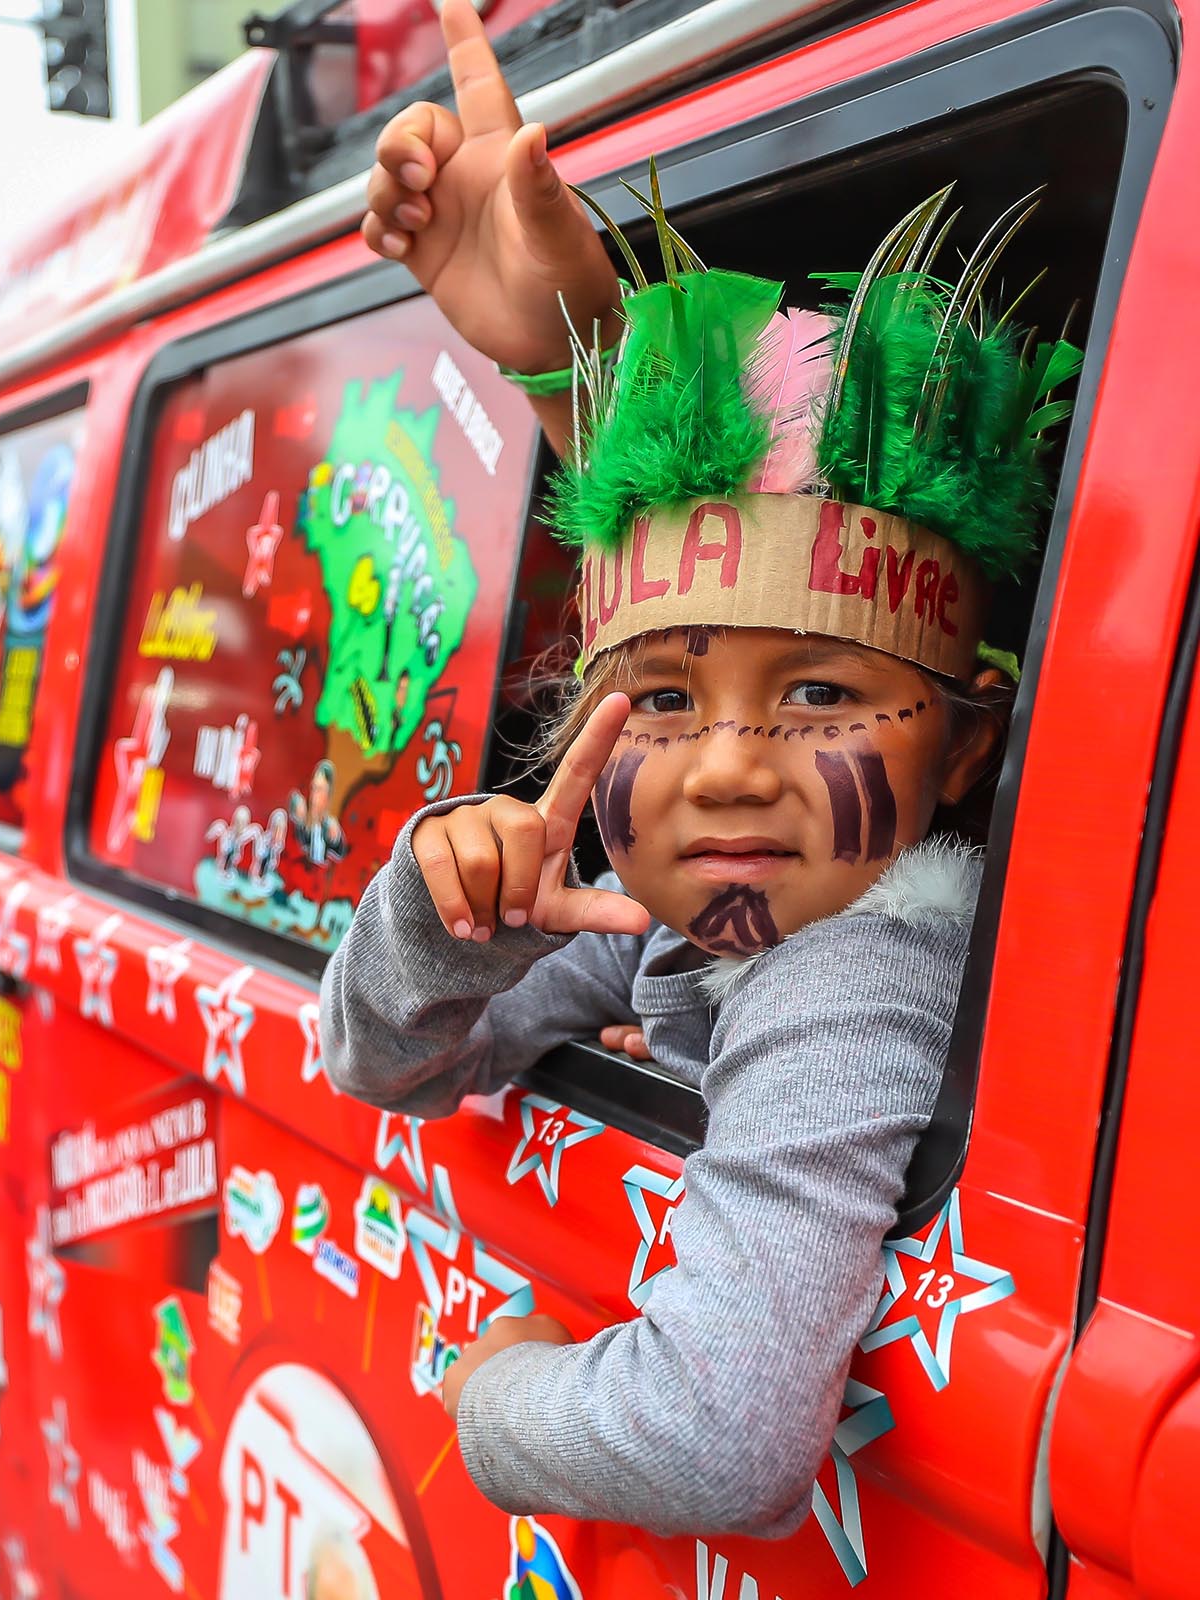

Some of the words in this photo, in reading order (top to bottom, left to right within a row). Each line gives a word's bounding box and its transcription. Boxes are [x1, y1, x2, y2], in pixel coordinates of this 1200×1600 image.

[582, 502, 743, 649] LULA
[538, 1117, 565, 1146] 13
[444, 1267, 487, 1334] PT
[913, 1268, 955, 1309] 13
[240, 1446, 303, 1599] PT
